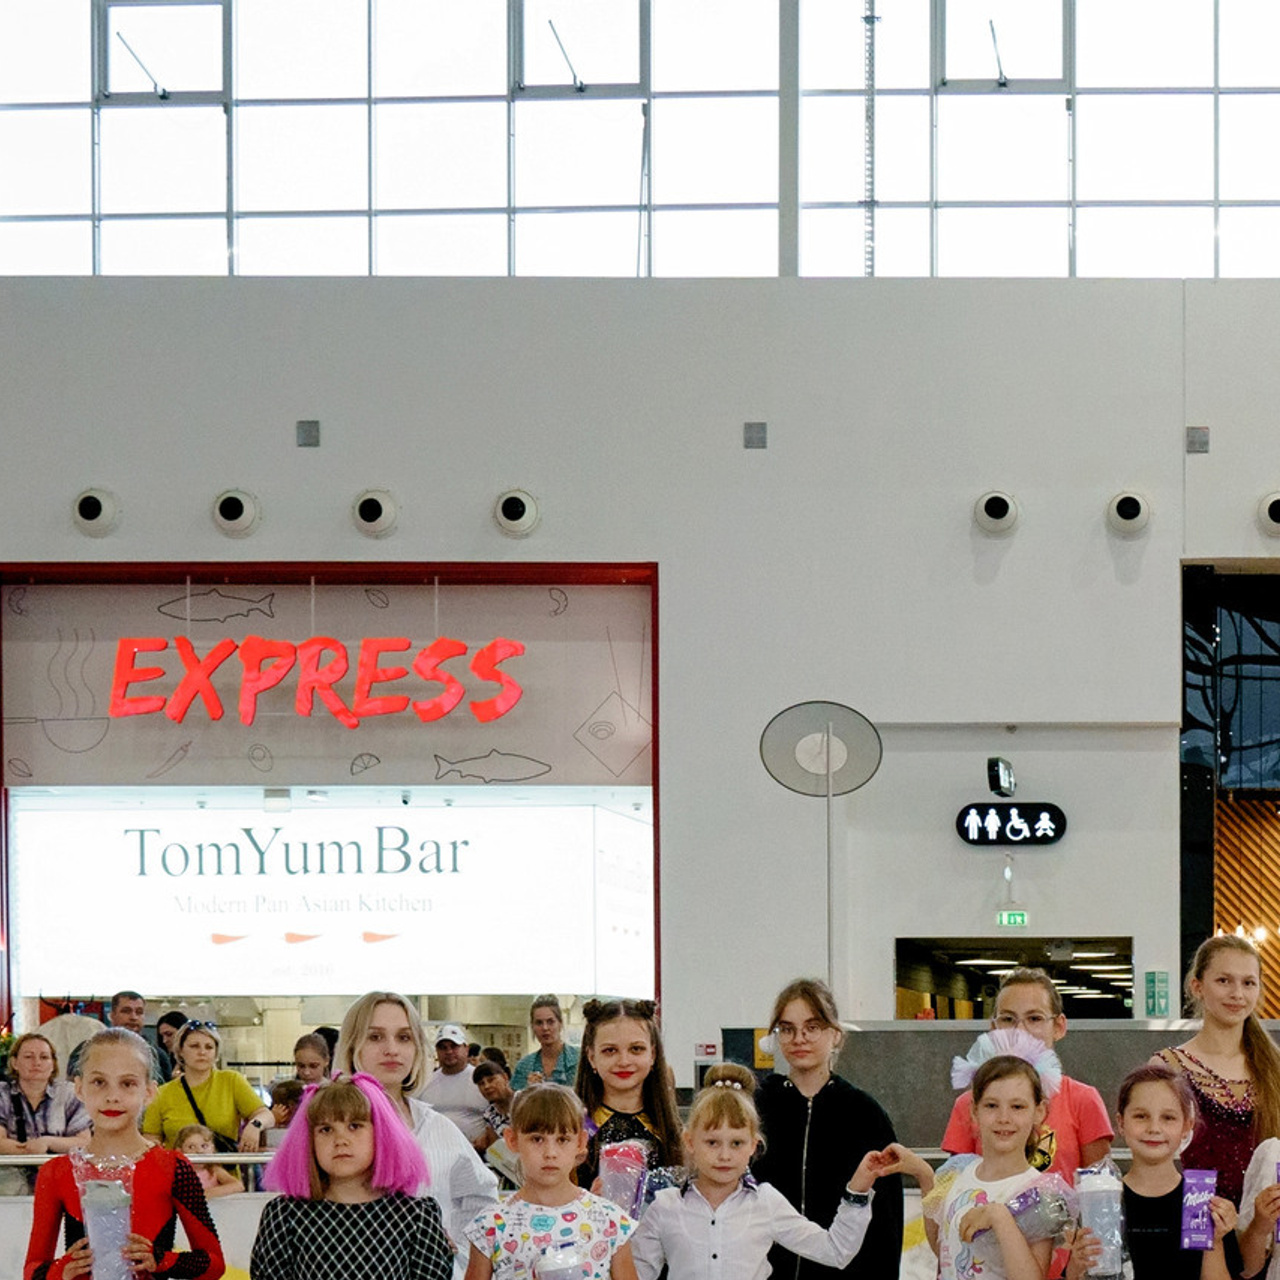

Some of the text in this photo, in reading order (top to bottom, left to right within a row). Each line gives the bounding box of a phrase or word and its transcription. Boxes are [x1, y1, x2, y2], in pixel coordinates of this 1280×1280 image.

[108, 634, 525, 729] EXPRESS
[124, 826, 469, 877] TomYumBar
[173, 892, 433, 914] Modern Pan Asian Kitchen
